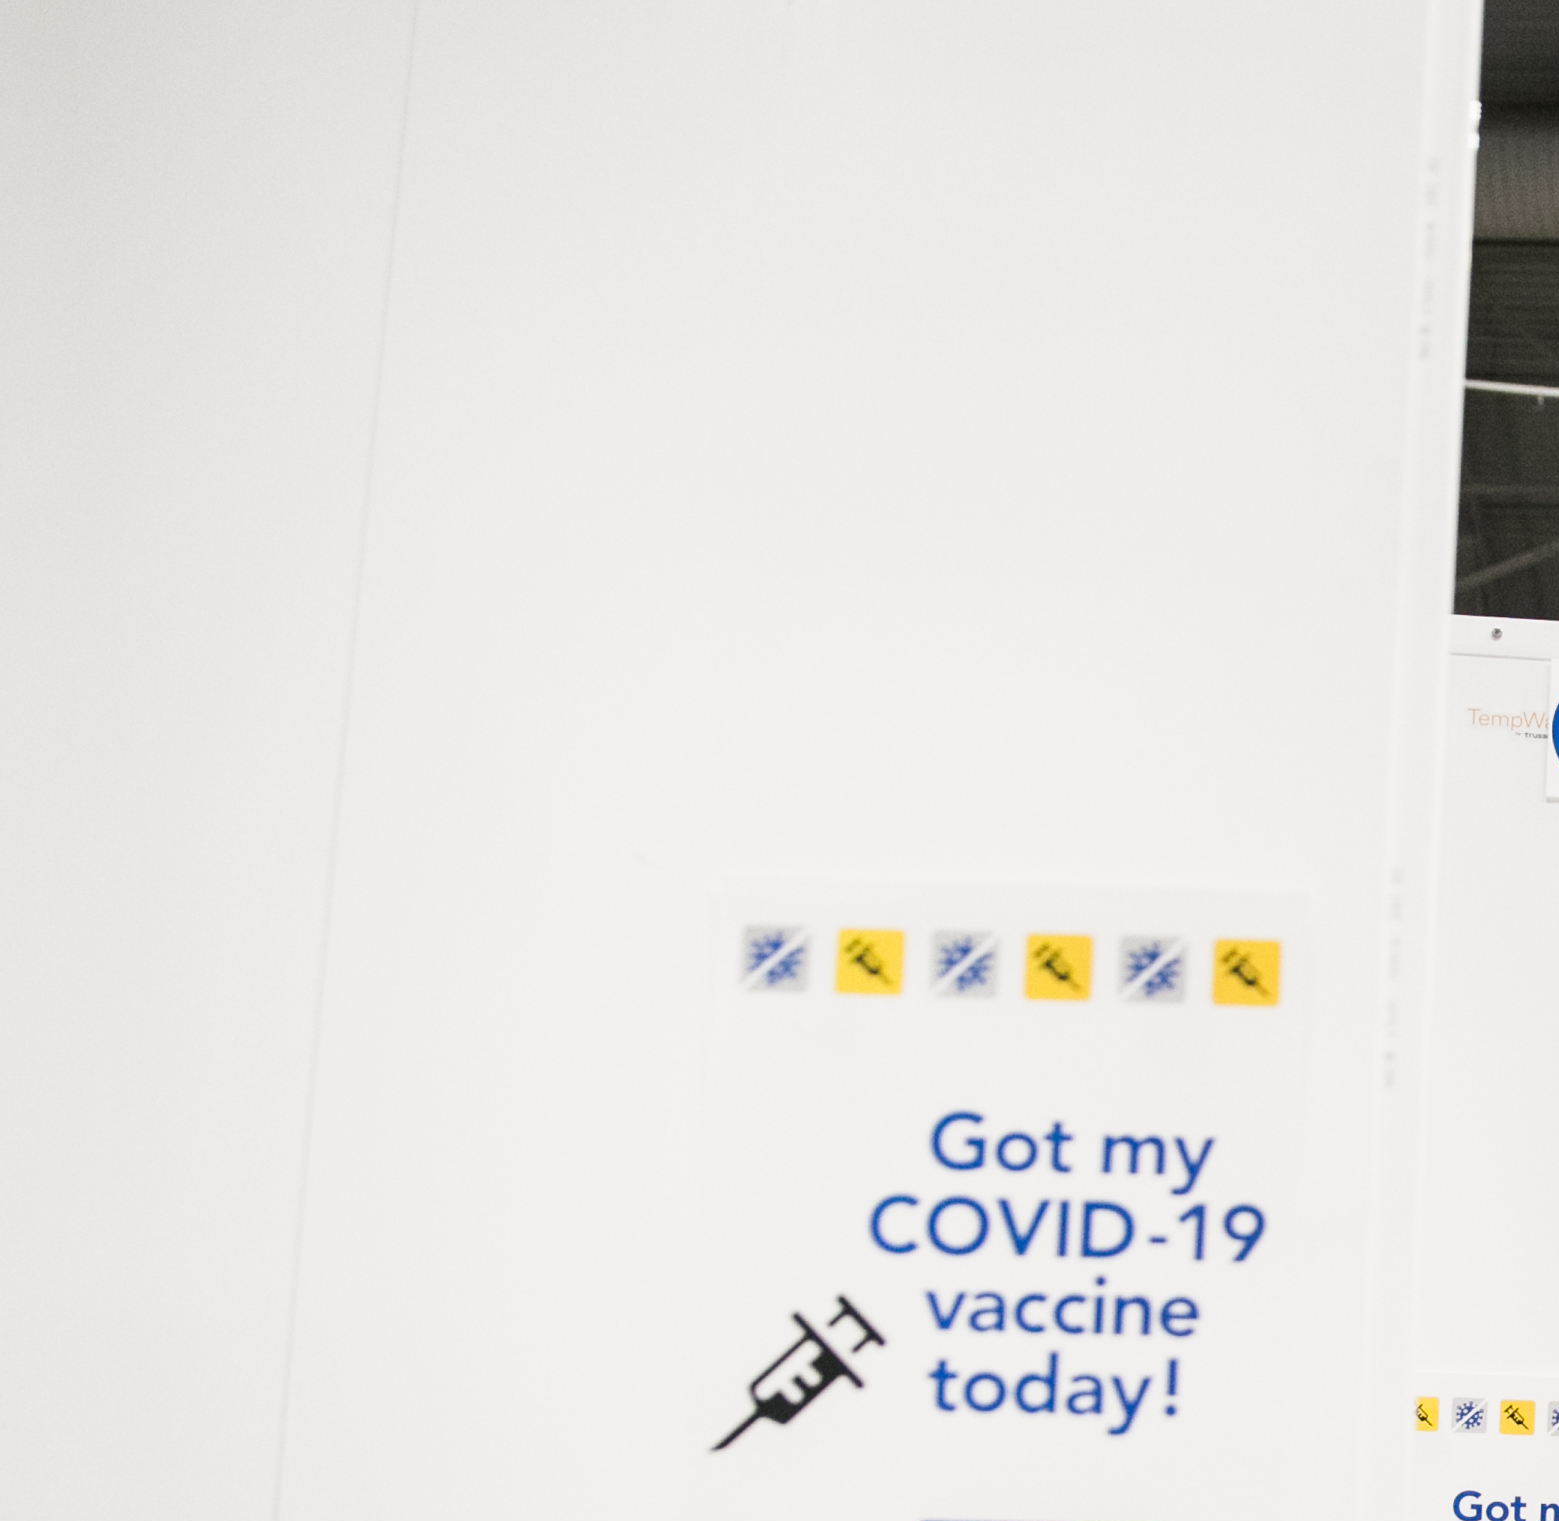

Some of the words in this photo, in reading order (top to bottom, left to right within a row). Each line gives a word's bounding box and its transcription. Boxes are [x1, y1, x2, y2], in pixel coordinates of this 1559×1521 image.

[929, 1110, 1074, 1175] Got
[1100, 1134, 1216, 1197] my
[867, 1195, 1268, 1264] COVID-19
[924, 1275, 1201, 1339] vaccine
[927, 1350, 1180, 1437] today!
